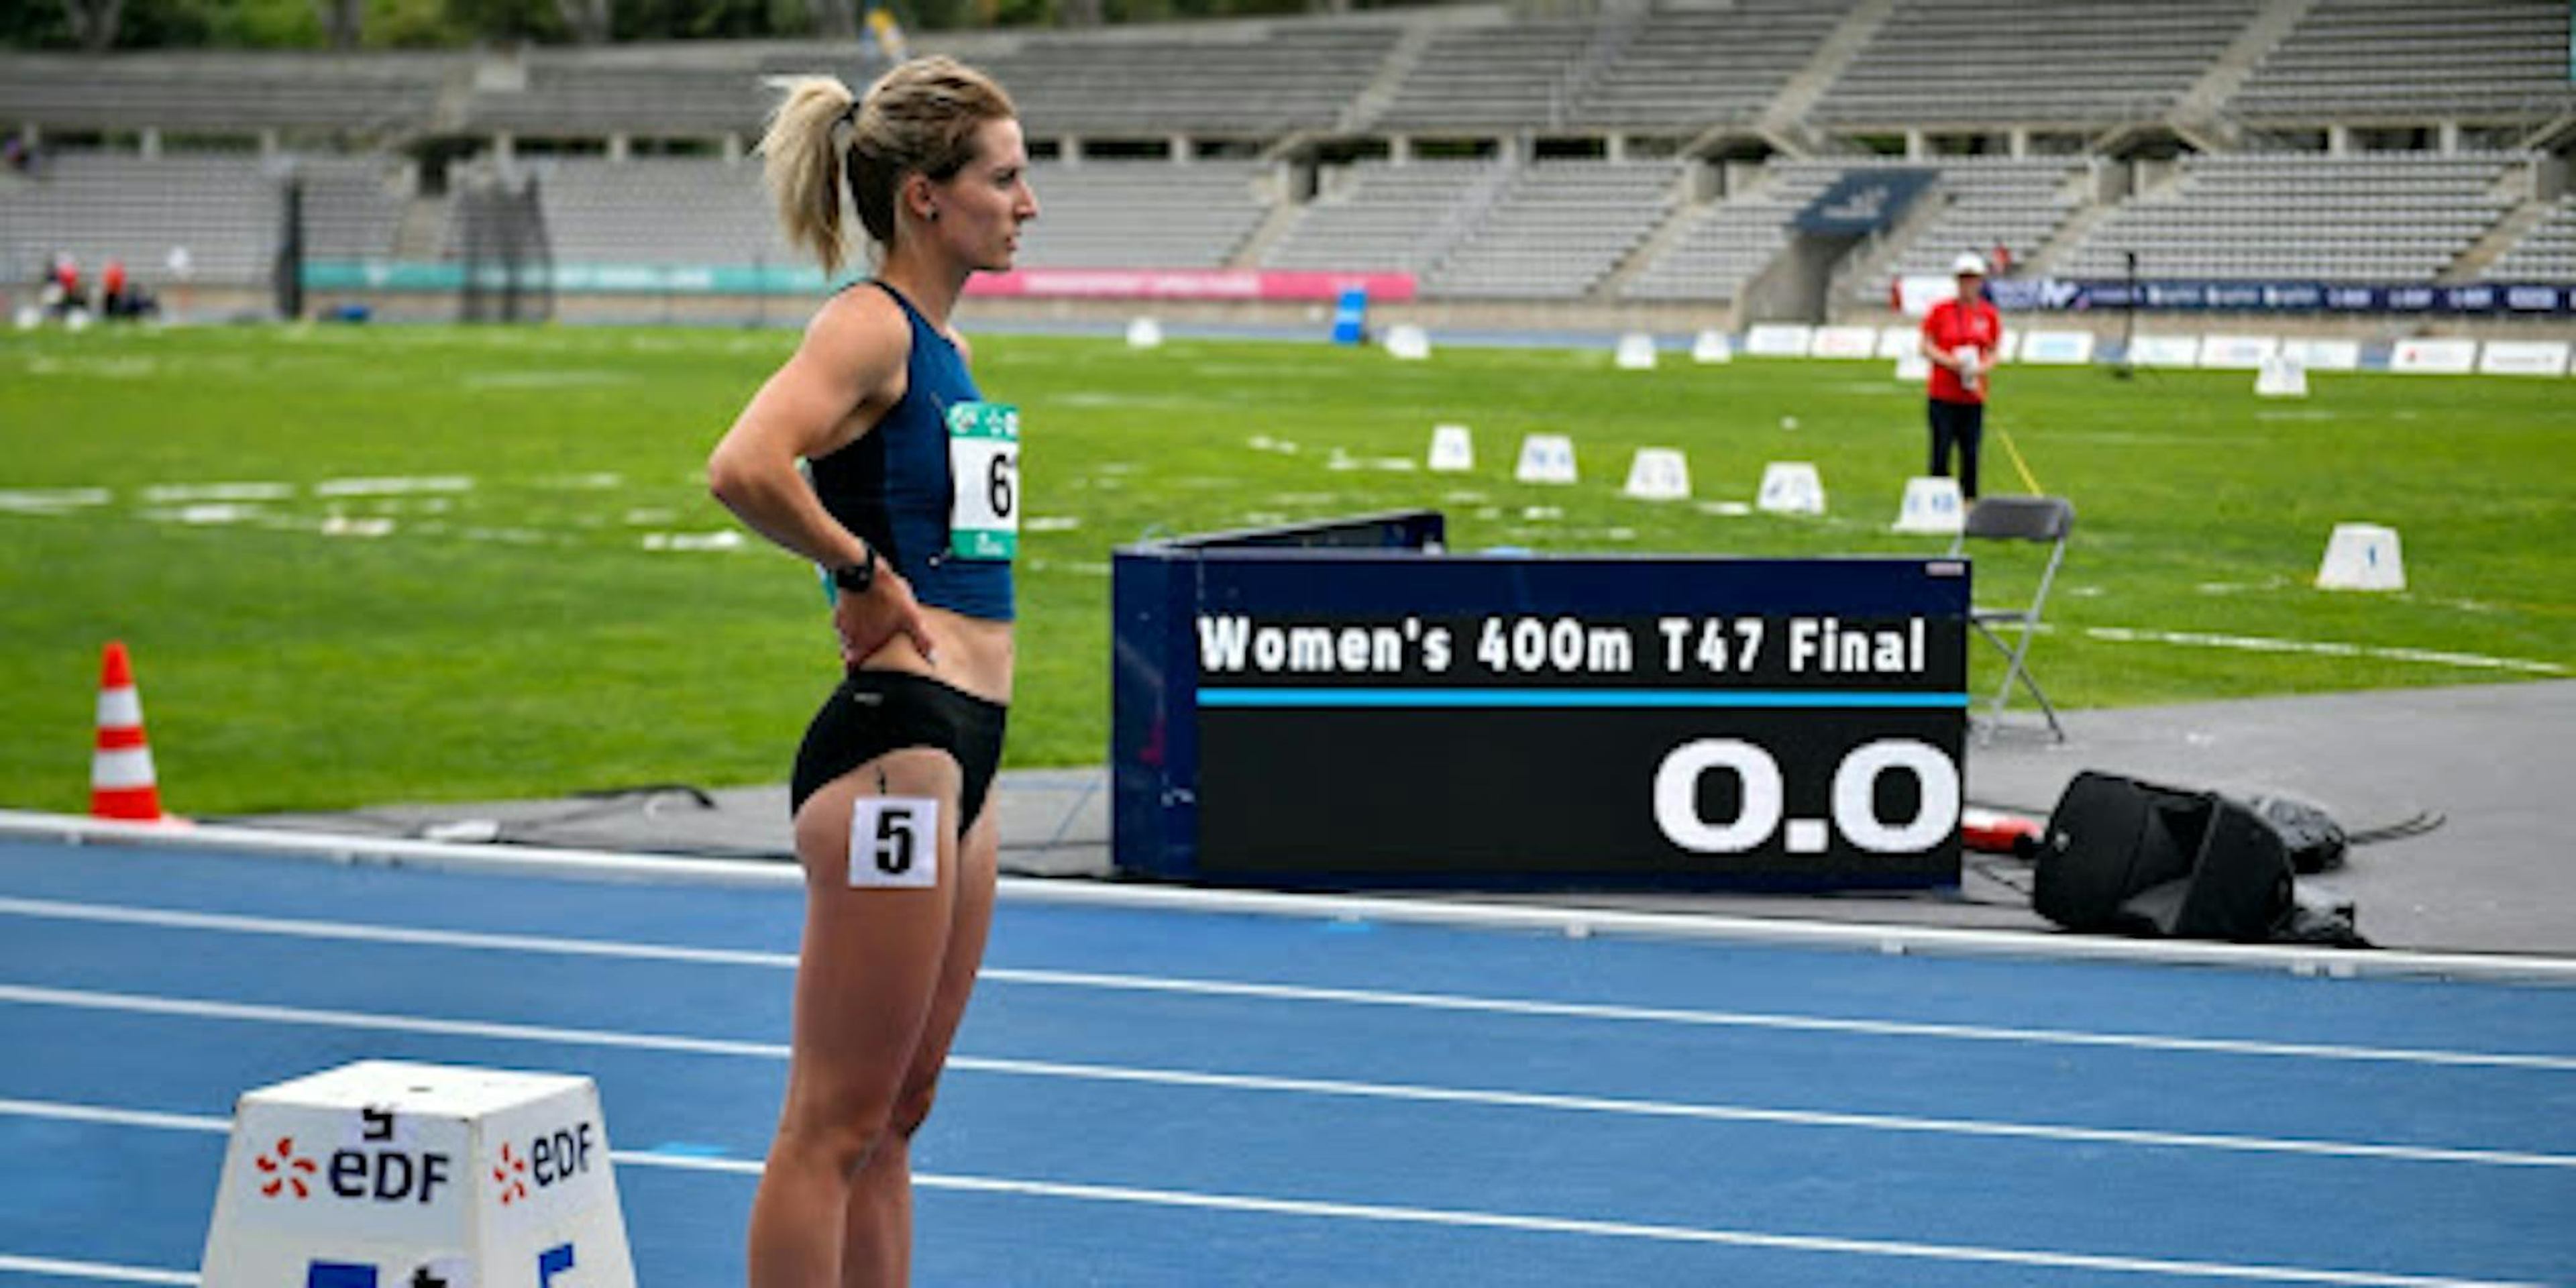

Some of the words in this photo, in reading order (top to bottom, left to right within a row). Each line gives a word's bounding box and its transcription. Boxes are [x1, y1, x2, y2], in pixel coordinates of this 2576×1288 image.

[1198, 616, 1450, 672] Women's
[1477, 616, 1632, 672] 400m
[1658, 617, 1763, 672] T47
[1789, 616, 1925, 672] Final
[1653, 738, 1960, 853] 0.0
[875, 809, 914, 875] 5
